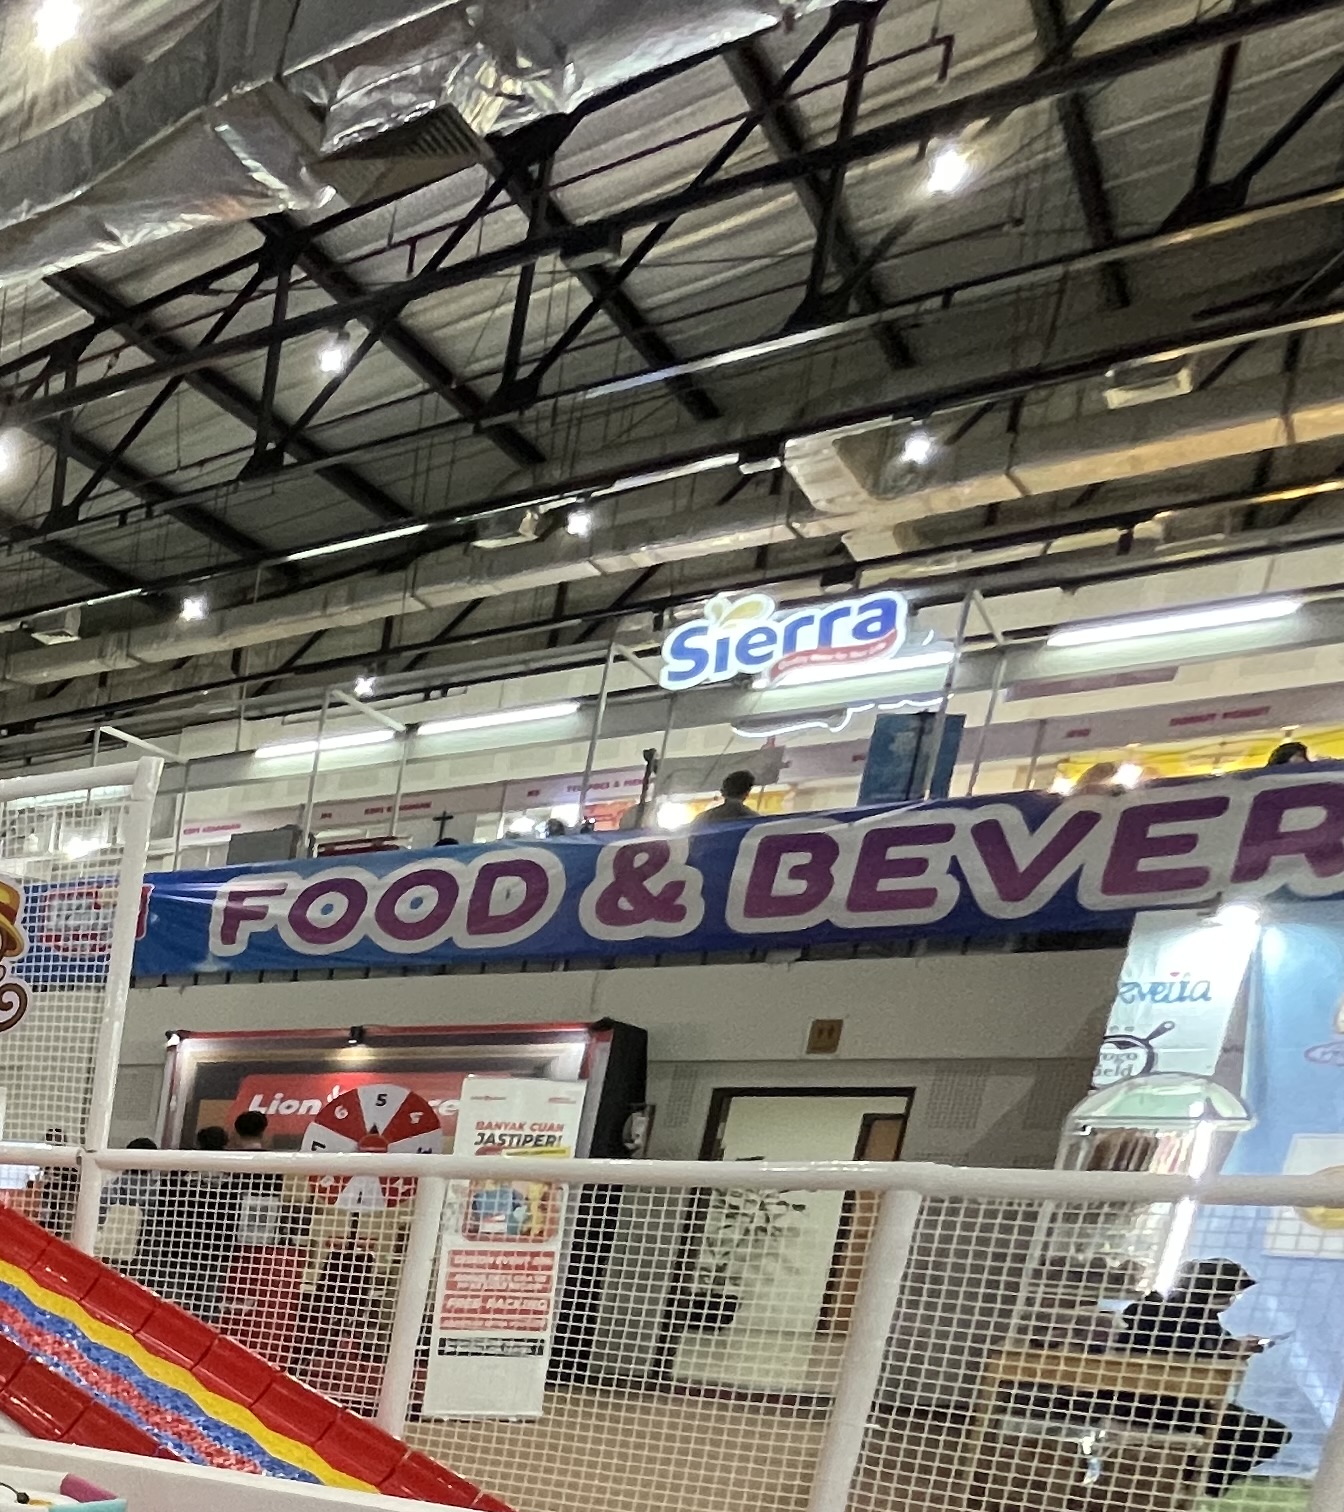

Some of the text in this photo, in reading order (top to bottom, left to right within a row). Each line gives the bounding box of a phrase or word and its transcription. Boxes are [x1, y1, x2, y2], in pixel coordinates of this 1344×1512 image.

[667, 597, 898, 682] Sierra
[216, 857, 553, 948] FOOD
[592, 838, 688, 929] &
[742, 781, 1344, 920] BEVER
[248, 1092, 322, 1116] Lion
[375, 1093, 388, 1107] 5
[334, 1104, 349, 1120] 6
[475, 1120, 565, 1133] BANYAK CUAN
[474, 1132, 563, 1147] JASTIPER!
